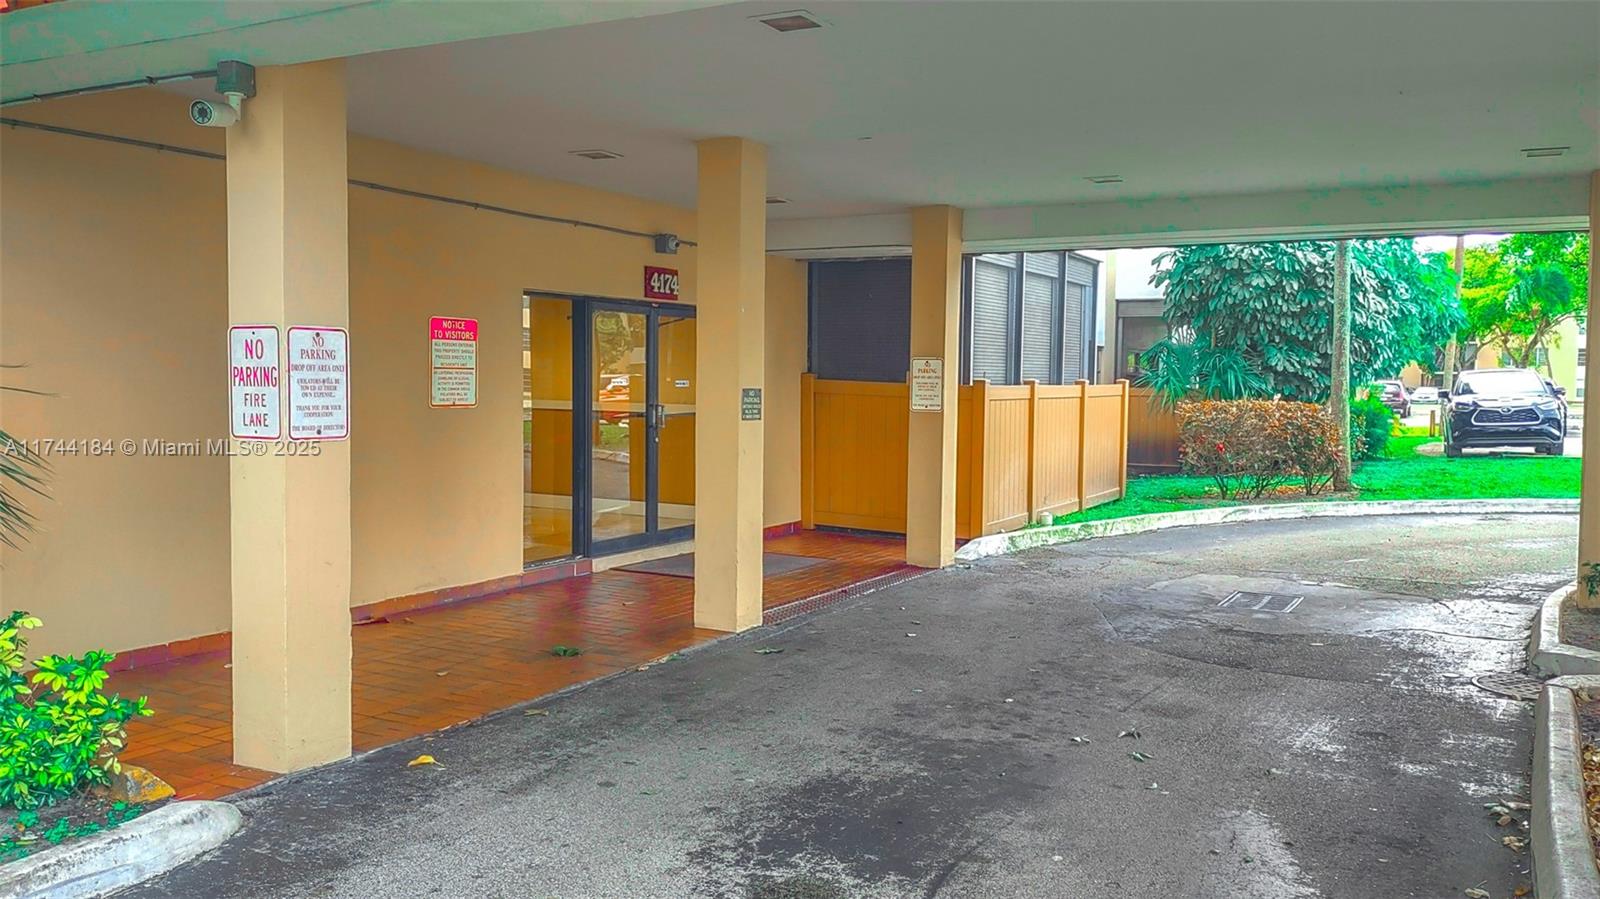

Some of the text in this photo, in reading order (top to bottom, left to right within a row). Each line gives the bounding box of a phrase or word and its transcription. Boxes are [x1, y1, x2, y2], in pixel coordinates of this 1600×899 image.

[650, 272, 679, 295] 4174
[442, 320, 465, 330] NOTICE
[434, 330, 474, 340] TO VISITORS
[312, 336, 324, 347] NO
[245, 339, 264, 359] NO
[300, 349, 336, 360] PARKING
[291, 364, 344, 372] DROP OFF AREA ONLY
[233, 366, 277, 387] PARKING
[244, 393, 266, 407] FIRE
[243, 413, 268, 427] LANE
